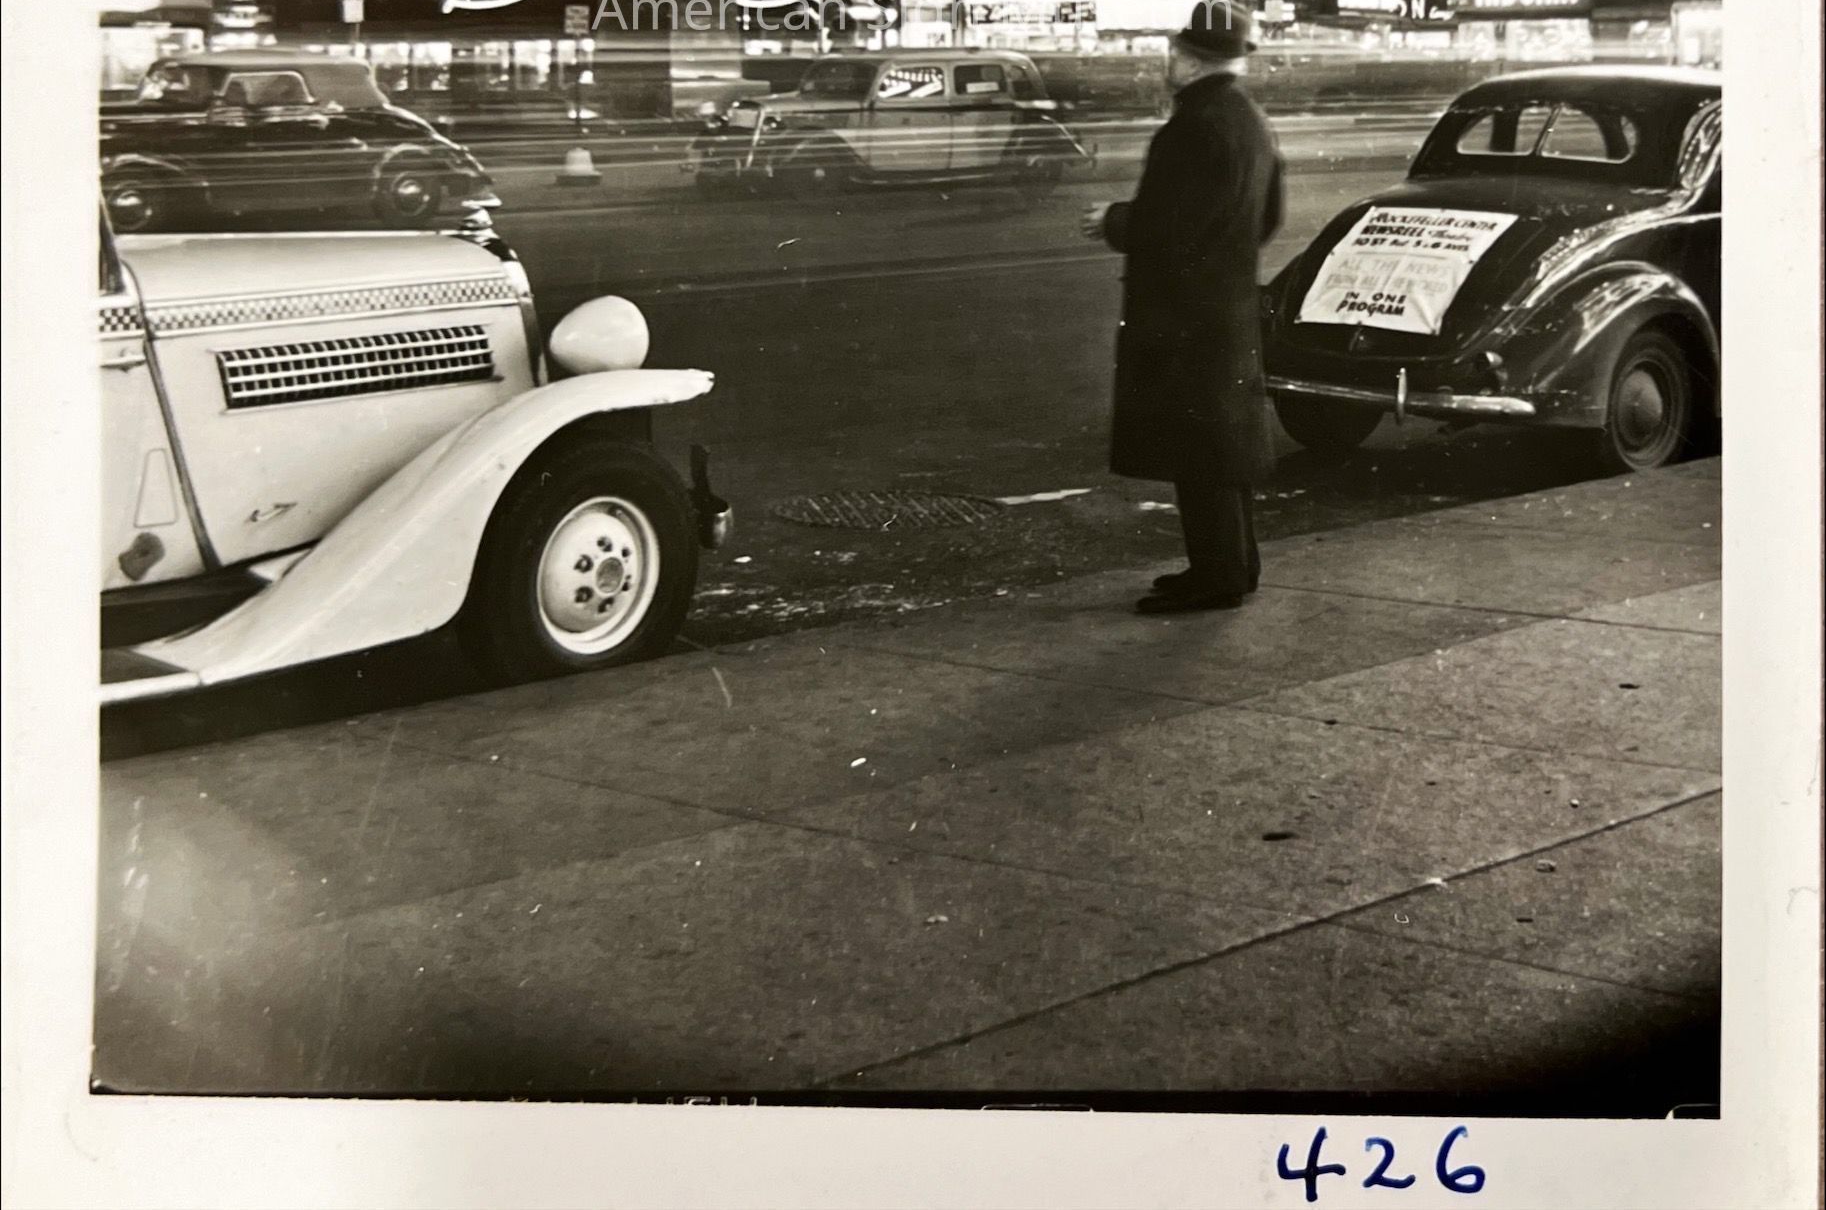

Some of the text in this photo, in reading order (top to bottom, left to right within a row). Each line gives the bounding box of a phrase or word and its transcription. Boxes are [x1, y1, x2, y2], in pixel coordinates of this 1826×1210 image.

[1345, 291, 1407, 304] IN ONE
[1335, 299, 1406, 317] PROGRAM
[1277, 1126, 1486, 1202] 426
